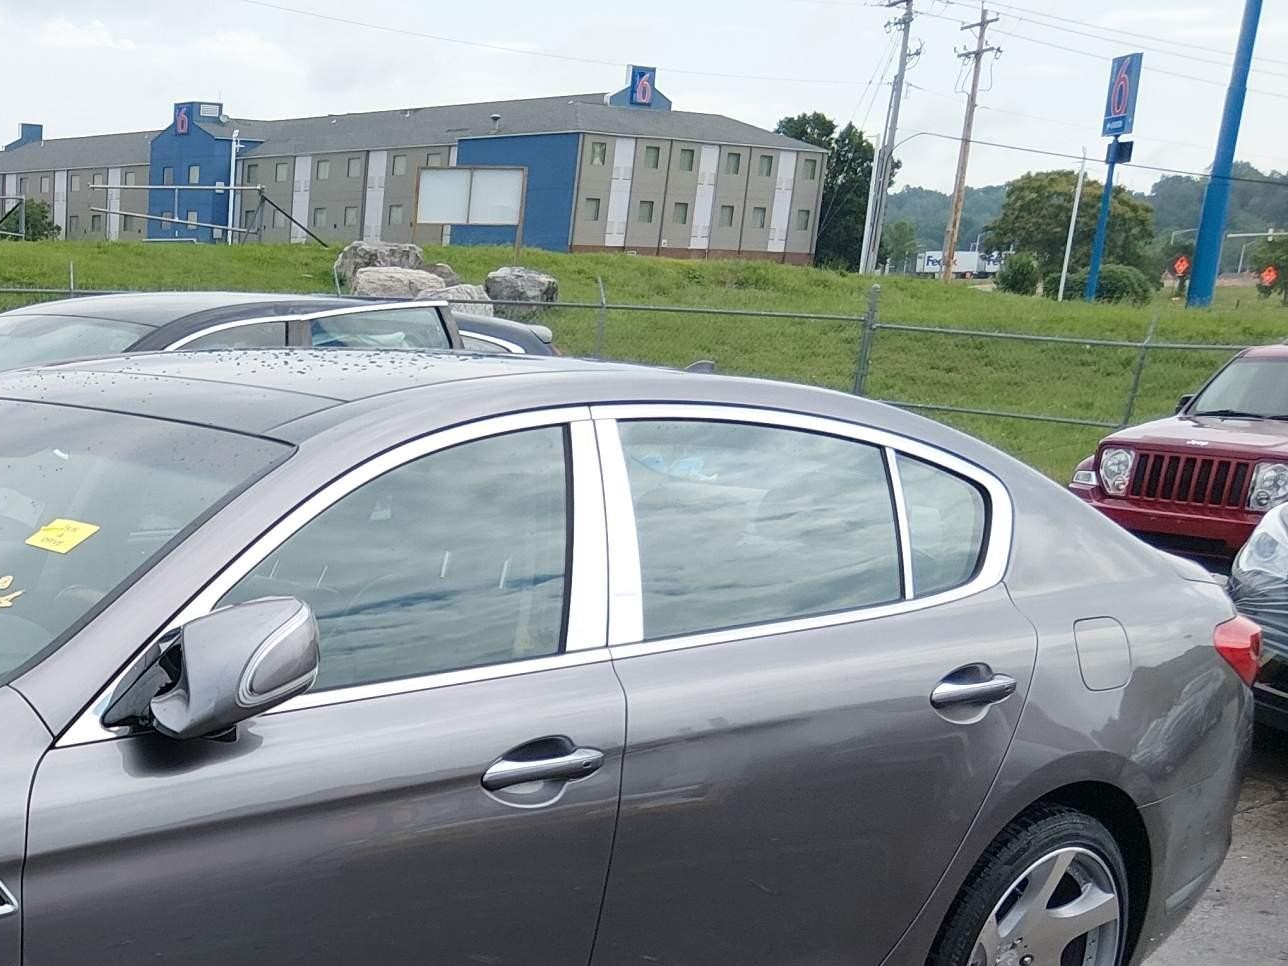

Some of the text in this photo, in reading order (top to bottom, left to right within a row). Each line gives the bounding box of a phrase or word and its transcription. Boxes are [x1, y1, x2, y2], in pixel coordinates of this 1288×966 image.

[636, 72, 652, 104] 6
[1111, 56, 1132, 116] 6
[176, 107, 188, 134] 6
